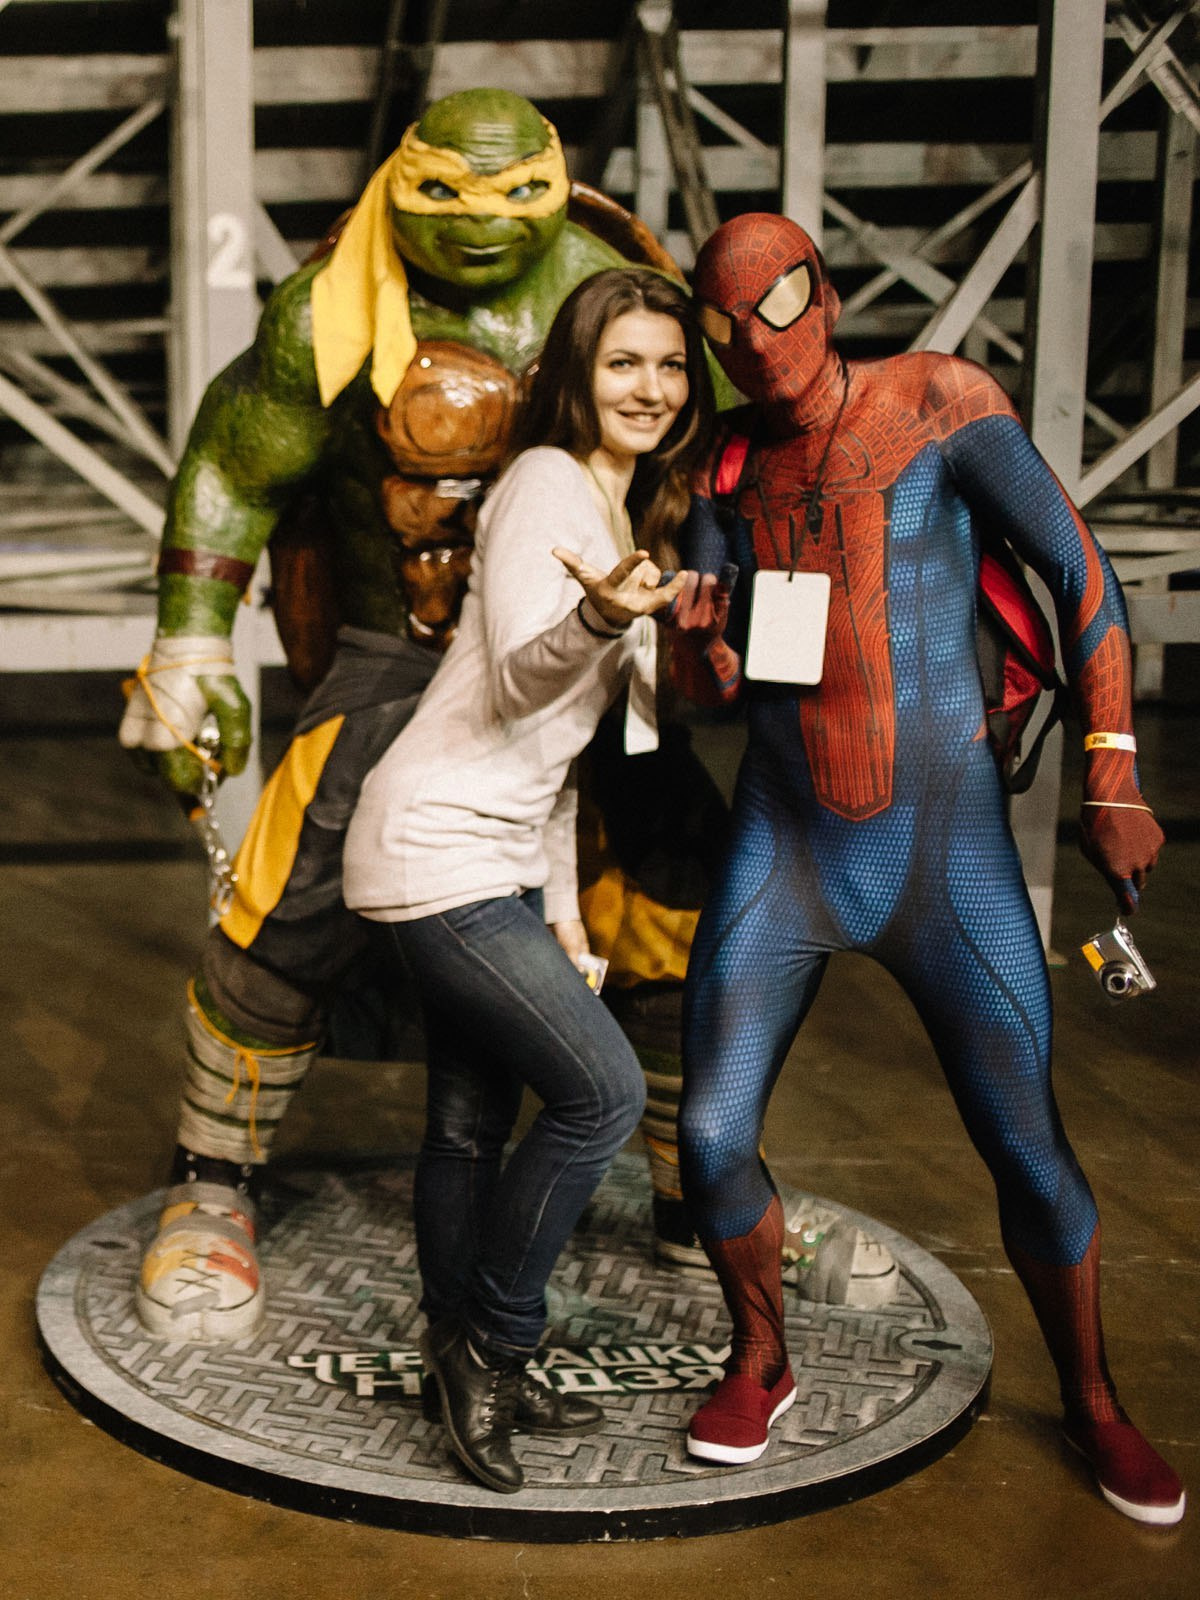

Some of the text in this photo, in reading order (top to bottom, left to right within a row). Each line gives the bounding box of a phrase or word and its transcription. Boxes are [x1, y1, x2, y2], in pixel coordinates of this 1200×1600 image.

[207, 213, 250, 287] 2
[287, 1344, 732, 1385] ЧЕРАШКИ
[355, 1364, 726, 1396] НДЗЯ
